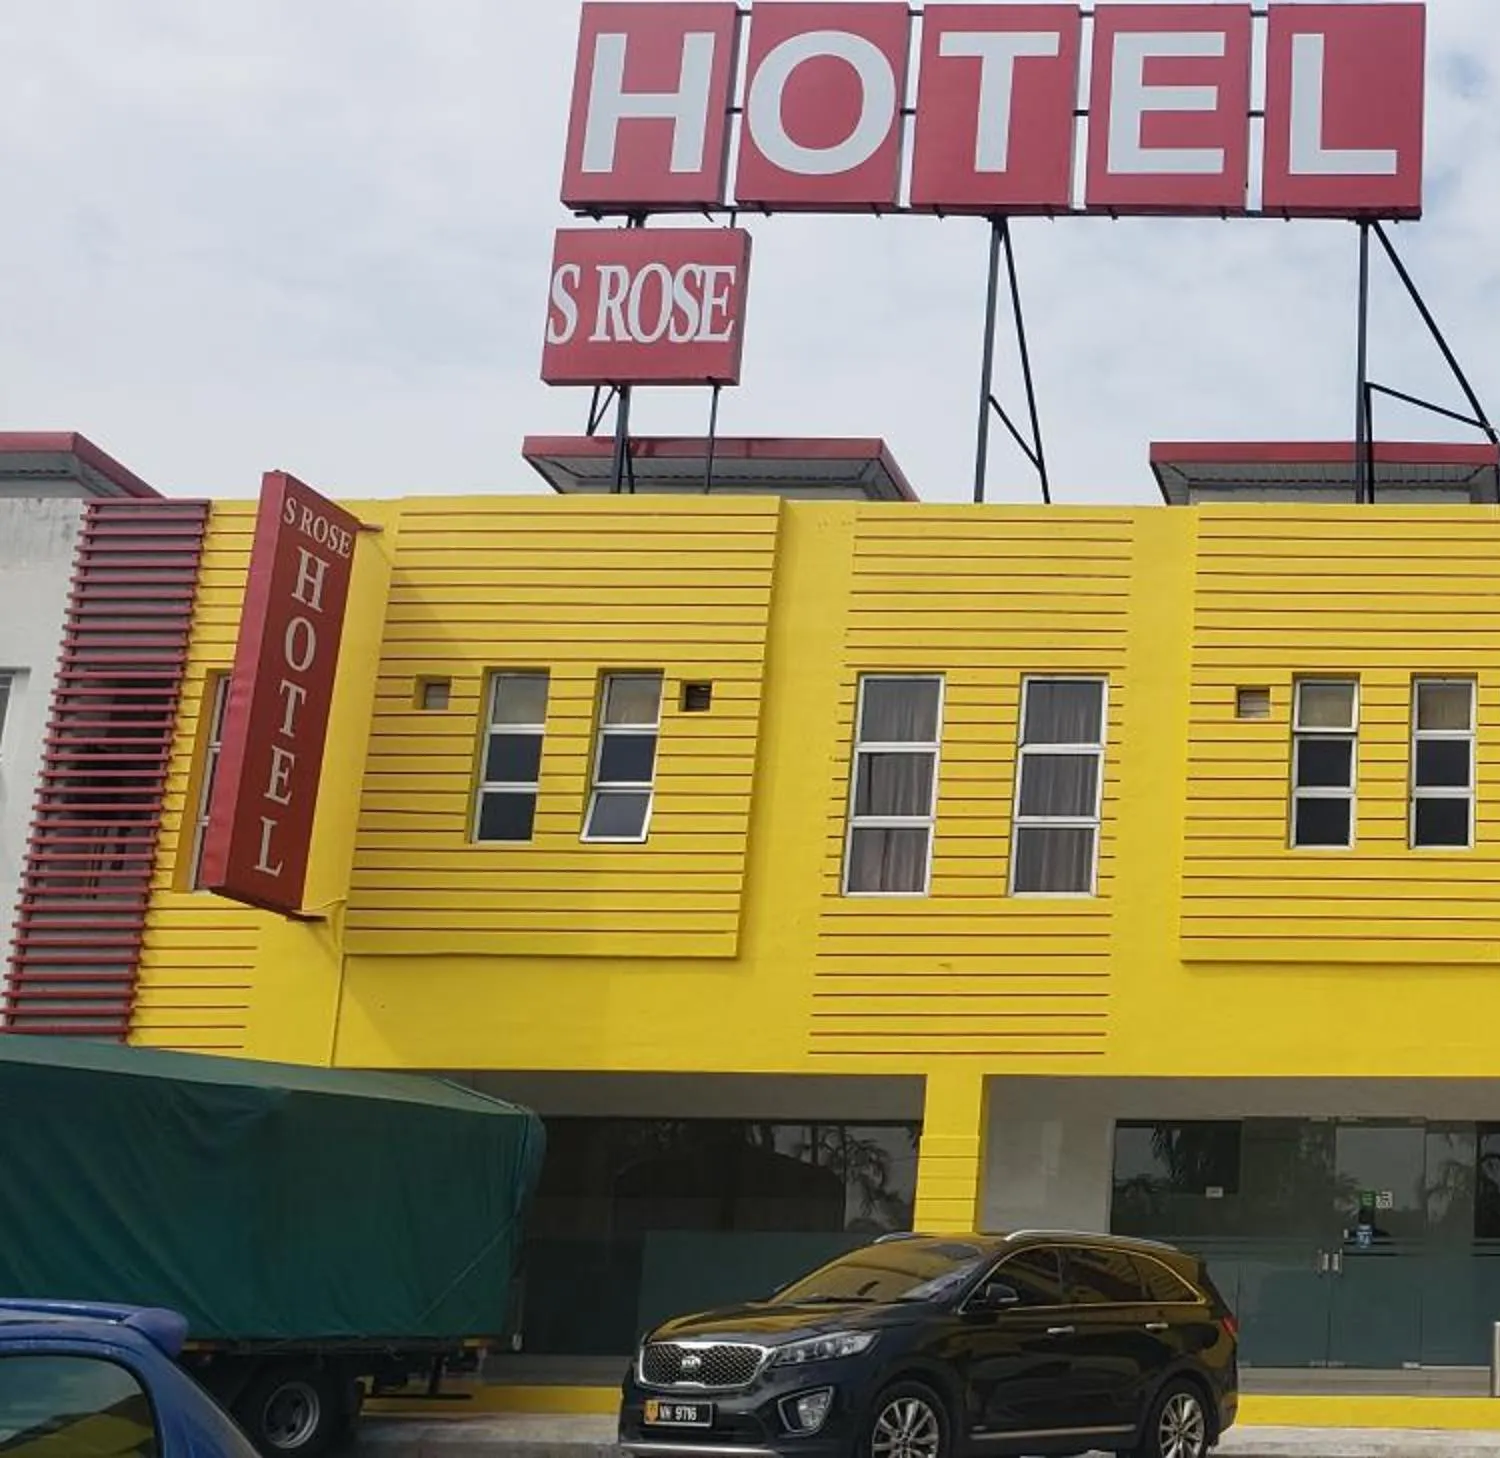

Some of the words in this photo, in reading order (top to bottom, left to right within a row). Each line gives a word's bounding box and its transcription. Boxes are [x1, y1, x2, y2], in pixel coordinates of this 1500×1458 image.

[582, 30, 1397, 175] HOTEL
[547, 263, 581, 345] S
[588, 263, 737, 344] ROSE
[283, 497, 297, 525] S
[299, 505, 353, 559] ROSE
[254, 546, 330, 878] HOTEL
